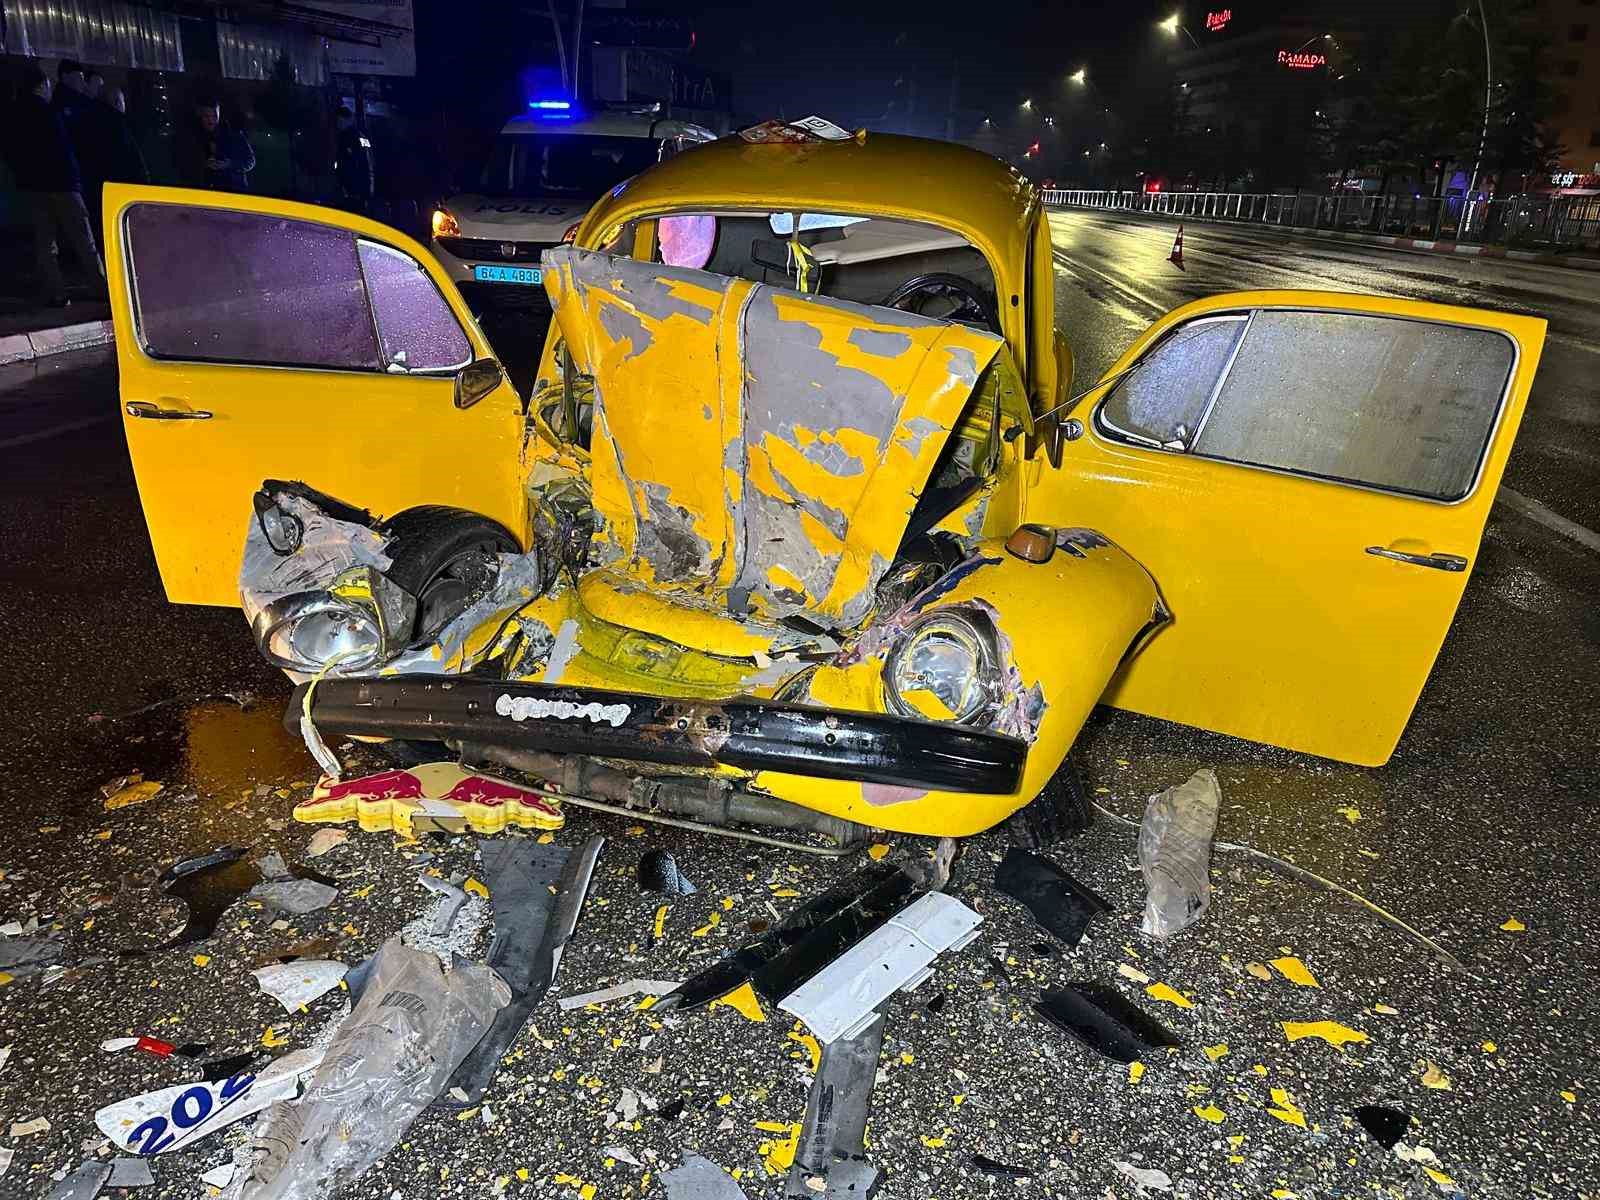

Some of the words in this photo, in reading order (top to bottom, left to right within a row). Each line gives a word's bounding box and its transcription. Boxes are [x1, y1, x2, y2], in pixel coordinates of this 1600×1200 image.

[1278, 51, 1325, 64] RAMADA
[481, 268, 496, 279] 64
[499, 269, 506, 280] A
[512, 270, 540, 282] 4838
